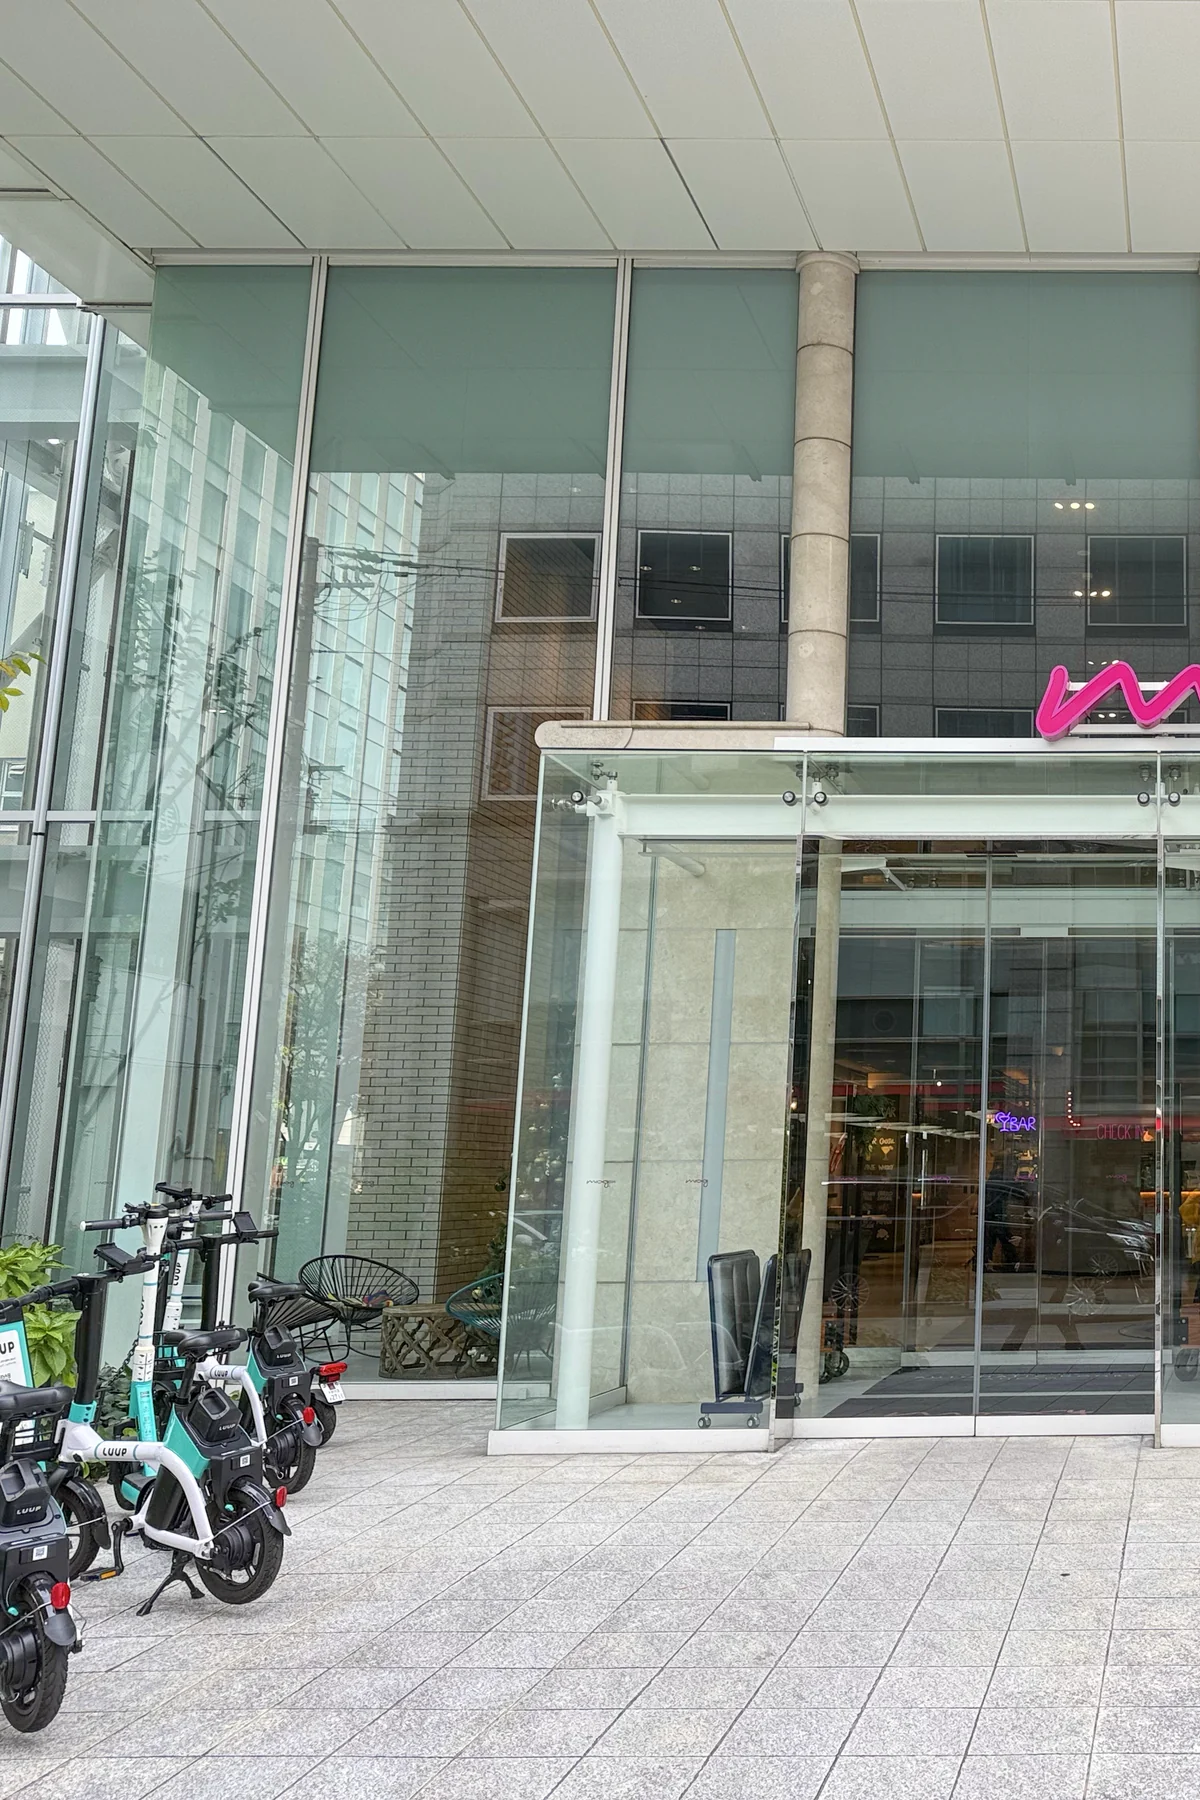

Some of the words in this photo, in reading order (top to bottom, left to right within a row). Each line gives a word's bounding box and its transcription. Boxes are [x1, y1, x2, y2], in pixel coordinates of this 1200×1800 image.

[1010, 1116, 1036, 1131] BAR
[1097, 1124, 1131, 1140] CHECK
[219, 1423, 236, 1431] LUUP
[102, 1447, 128, 1457] LUUP
[16, 1505, 42, 1516] LUUP
